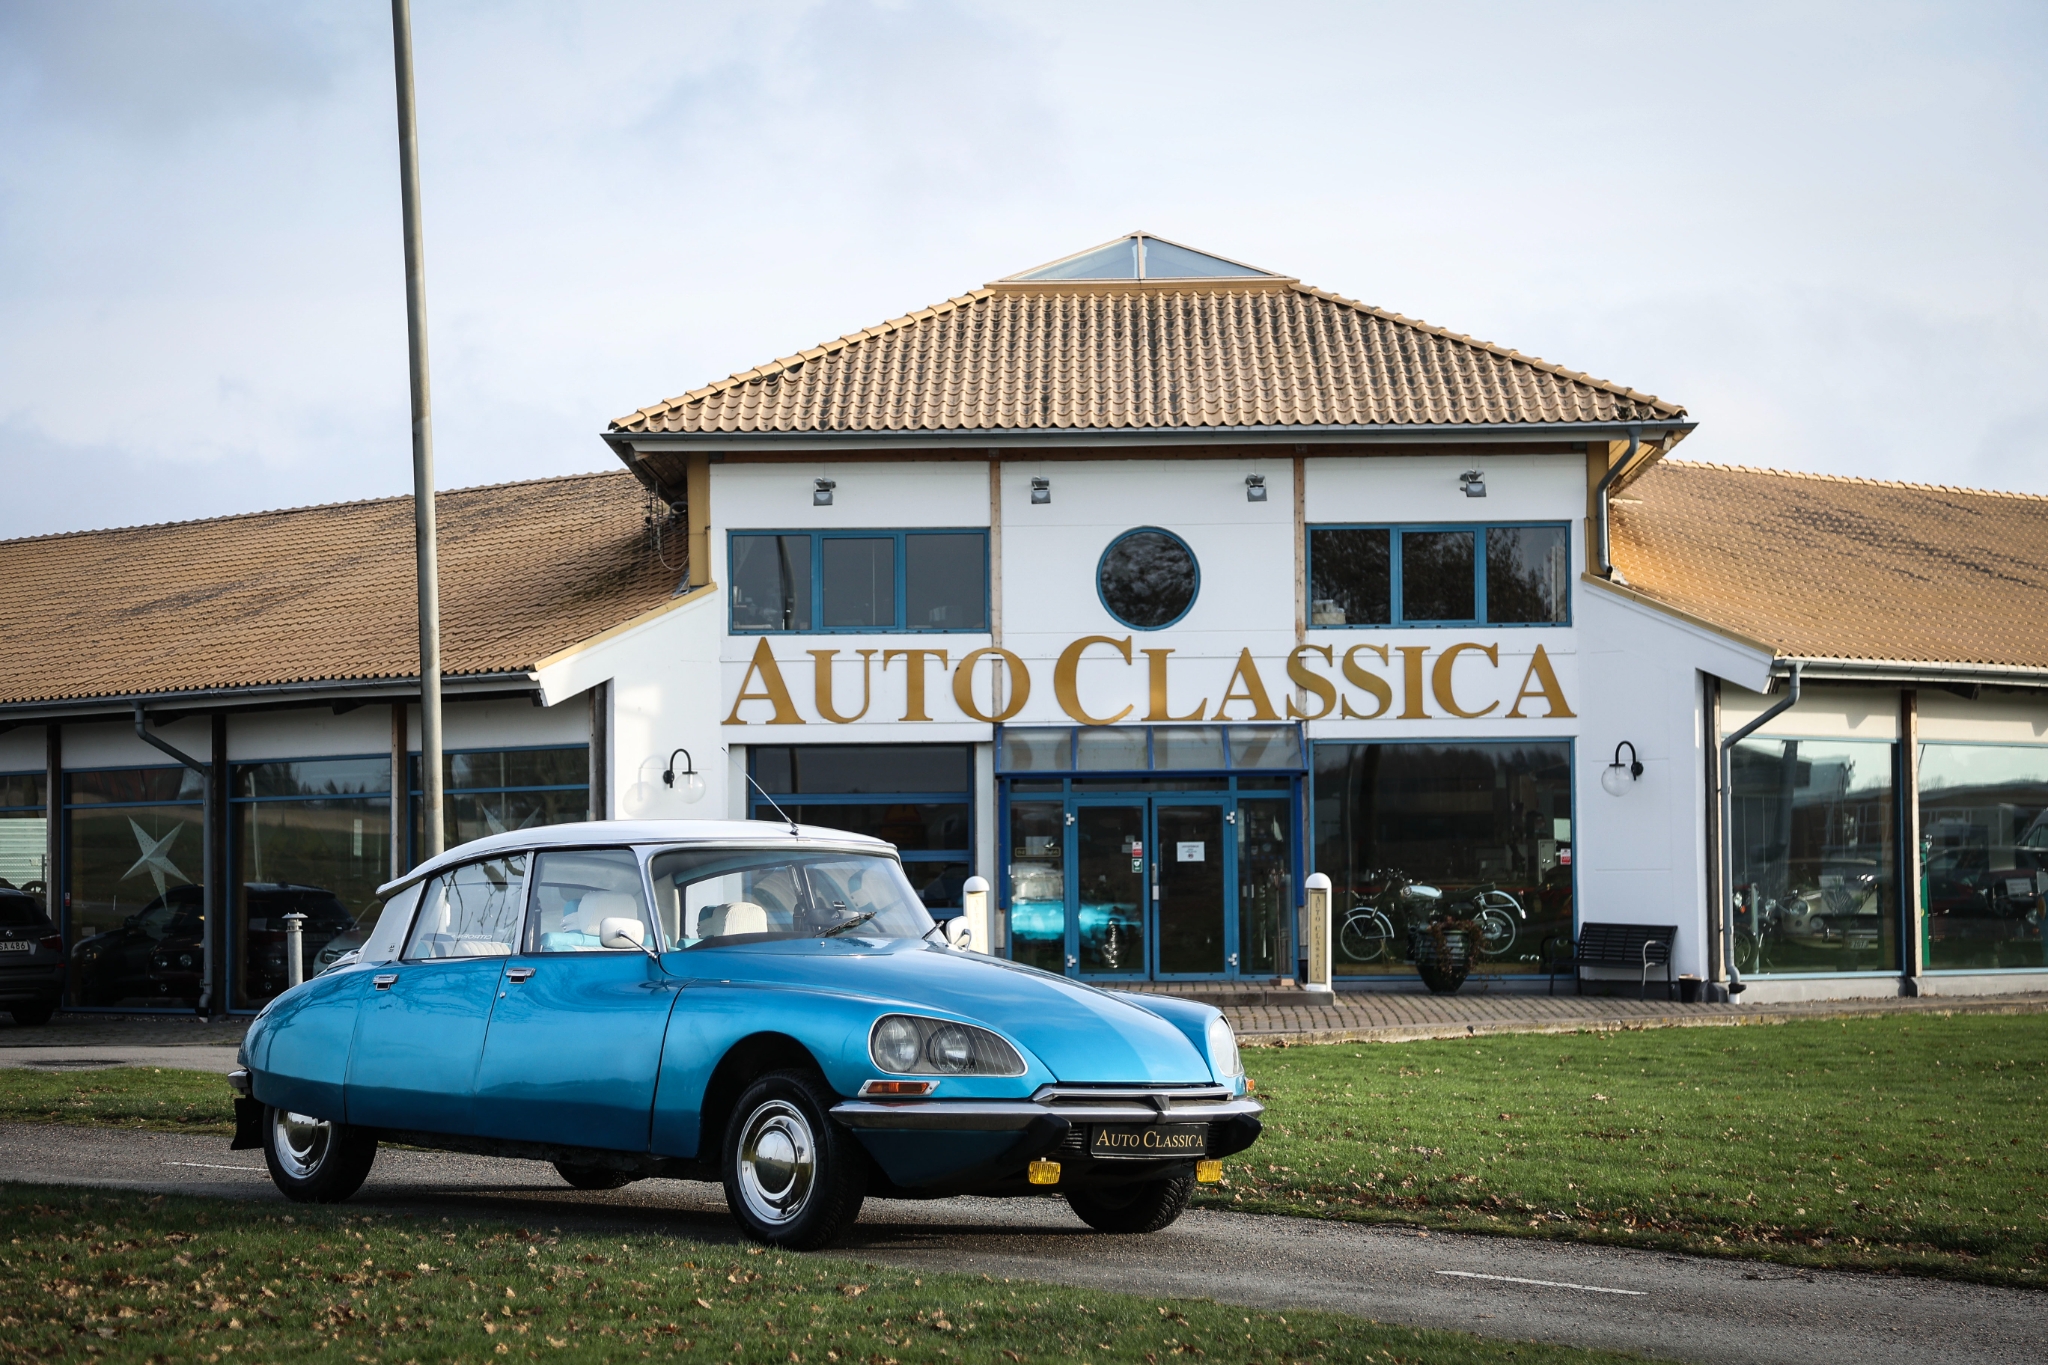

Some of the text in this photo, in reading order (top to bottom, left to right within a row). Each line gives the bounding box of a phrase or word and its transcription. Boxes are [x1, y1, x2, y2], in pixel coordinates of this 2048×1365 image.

[721, 635, 1578, 726] AUTO CLASSICA
[10, 942, 26, 950] 486
[1096, 1129, 1204, 1148] AUTO CLASSICA
